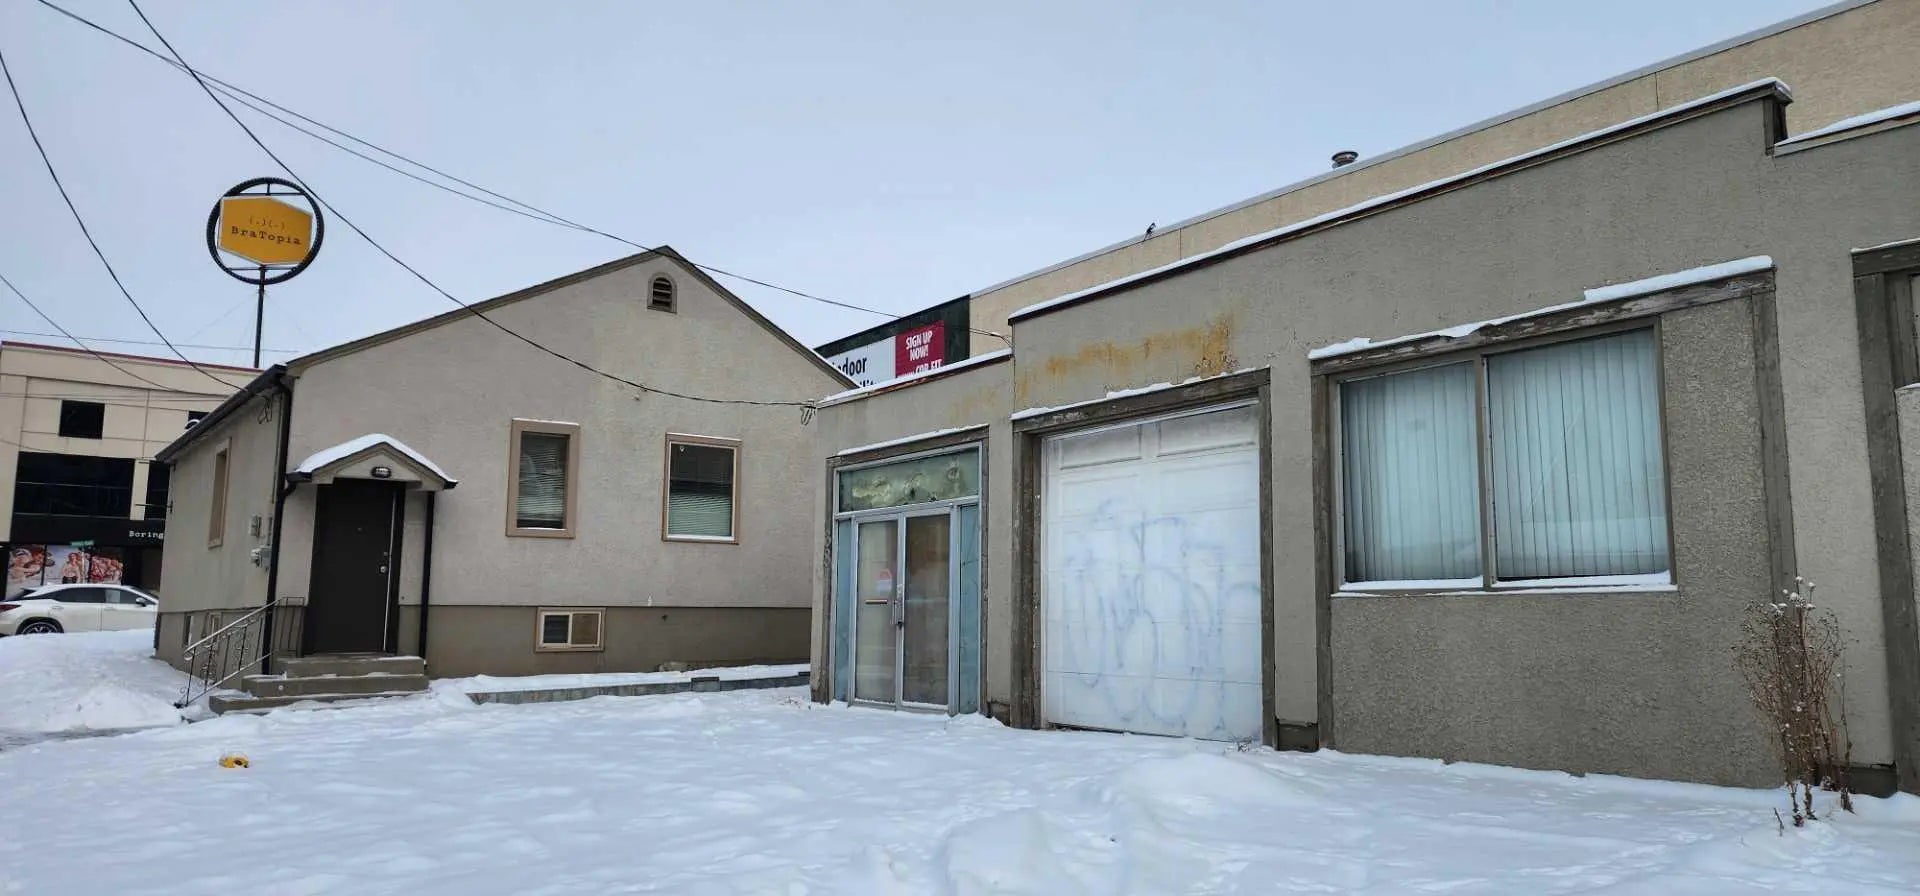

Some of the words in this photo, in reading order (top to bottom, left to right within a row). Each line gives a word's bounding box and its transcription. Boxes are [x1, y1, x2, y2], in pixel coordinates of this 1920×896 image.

[231, 225, 302, 245] BraTopia
[905, 333, 922, 350] SIGN
[922, 330, 933, 345] UP
[129, 530, 164, 540] Boring
